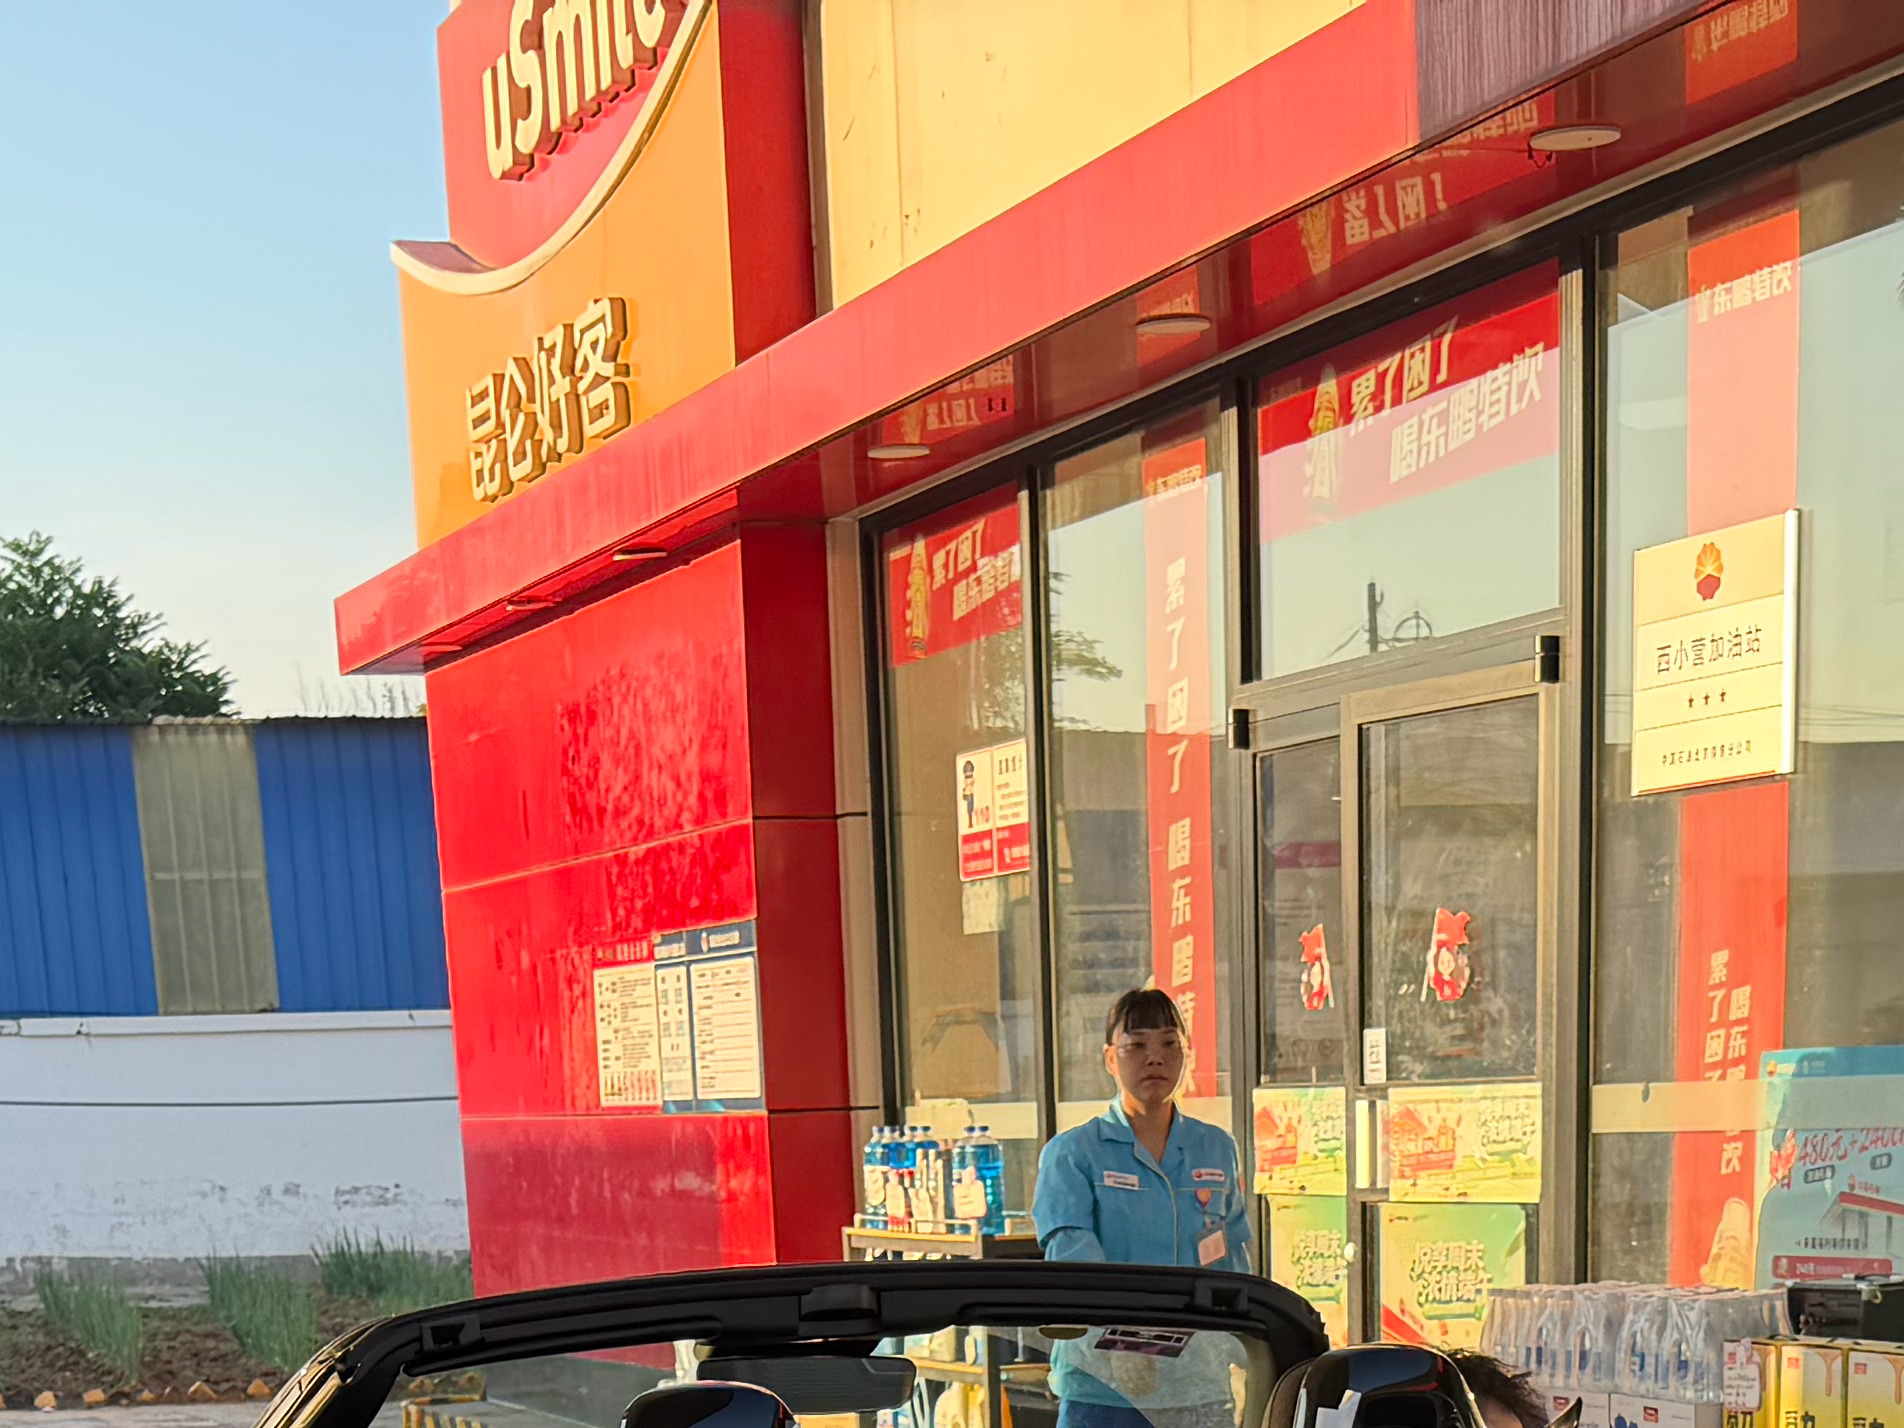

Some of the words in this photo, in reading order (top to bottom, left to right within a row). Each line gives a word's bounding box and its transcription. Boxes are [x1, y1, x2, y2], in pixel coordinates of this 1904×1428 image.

[466, 297, 629, 502] 昆仑好客
[1350, 316, 1459, 436] 累了困了
[1390, 342, 1544, 484] 喝东鹏特饮
